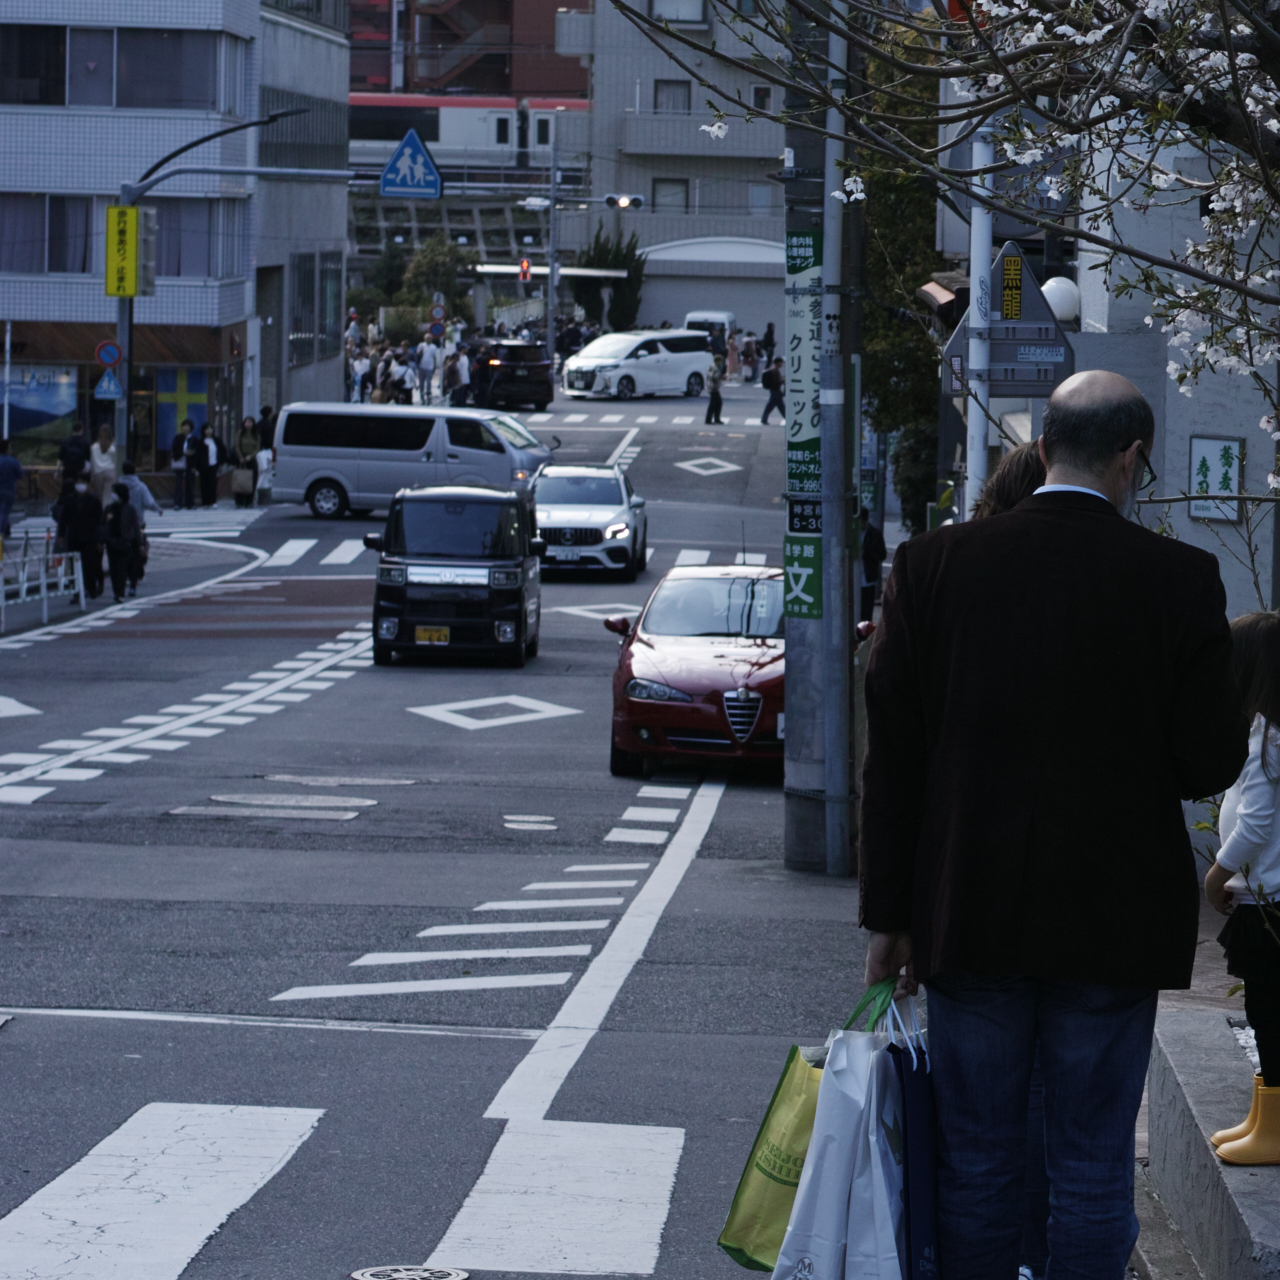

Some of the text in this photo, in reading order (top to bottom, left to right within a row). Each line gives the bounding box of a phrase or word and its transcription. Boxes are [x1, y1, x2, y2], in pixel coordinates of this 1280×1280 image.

[1003, 256, 1021, 319] 黒龍
[790, 333, 806, 438] クリニック
[1193, 504, 1211, 512] SUSHI
